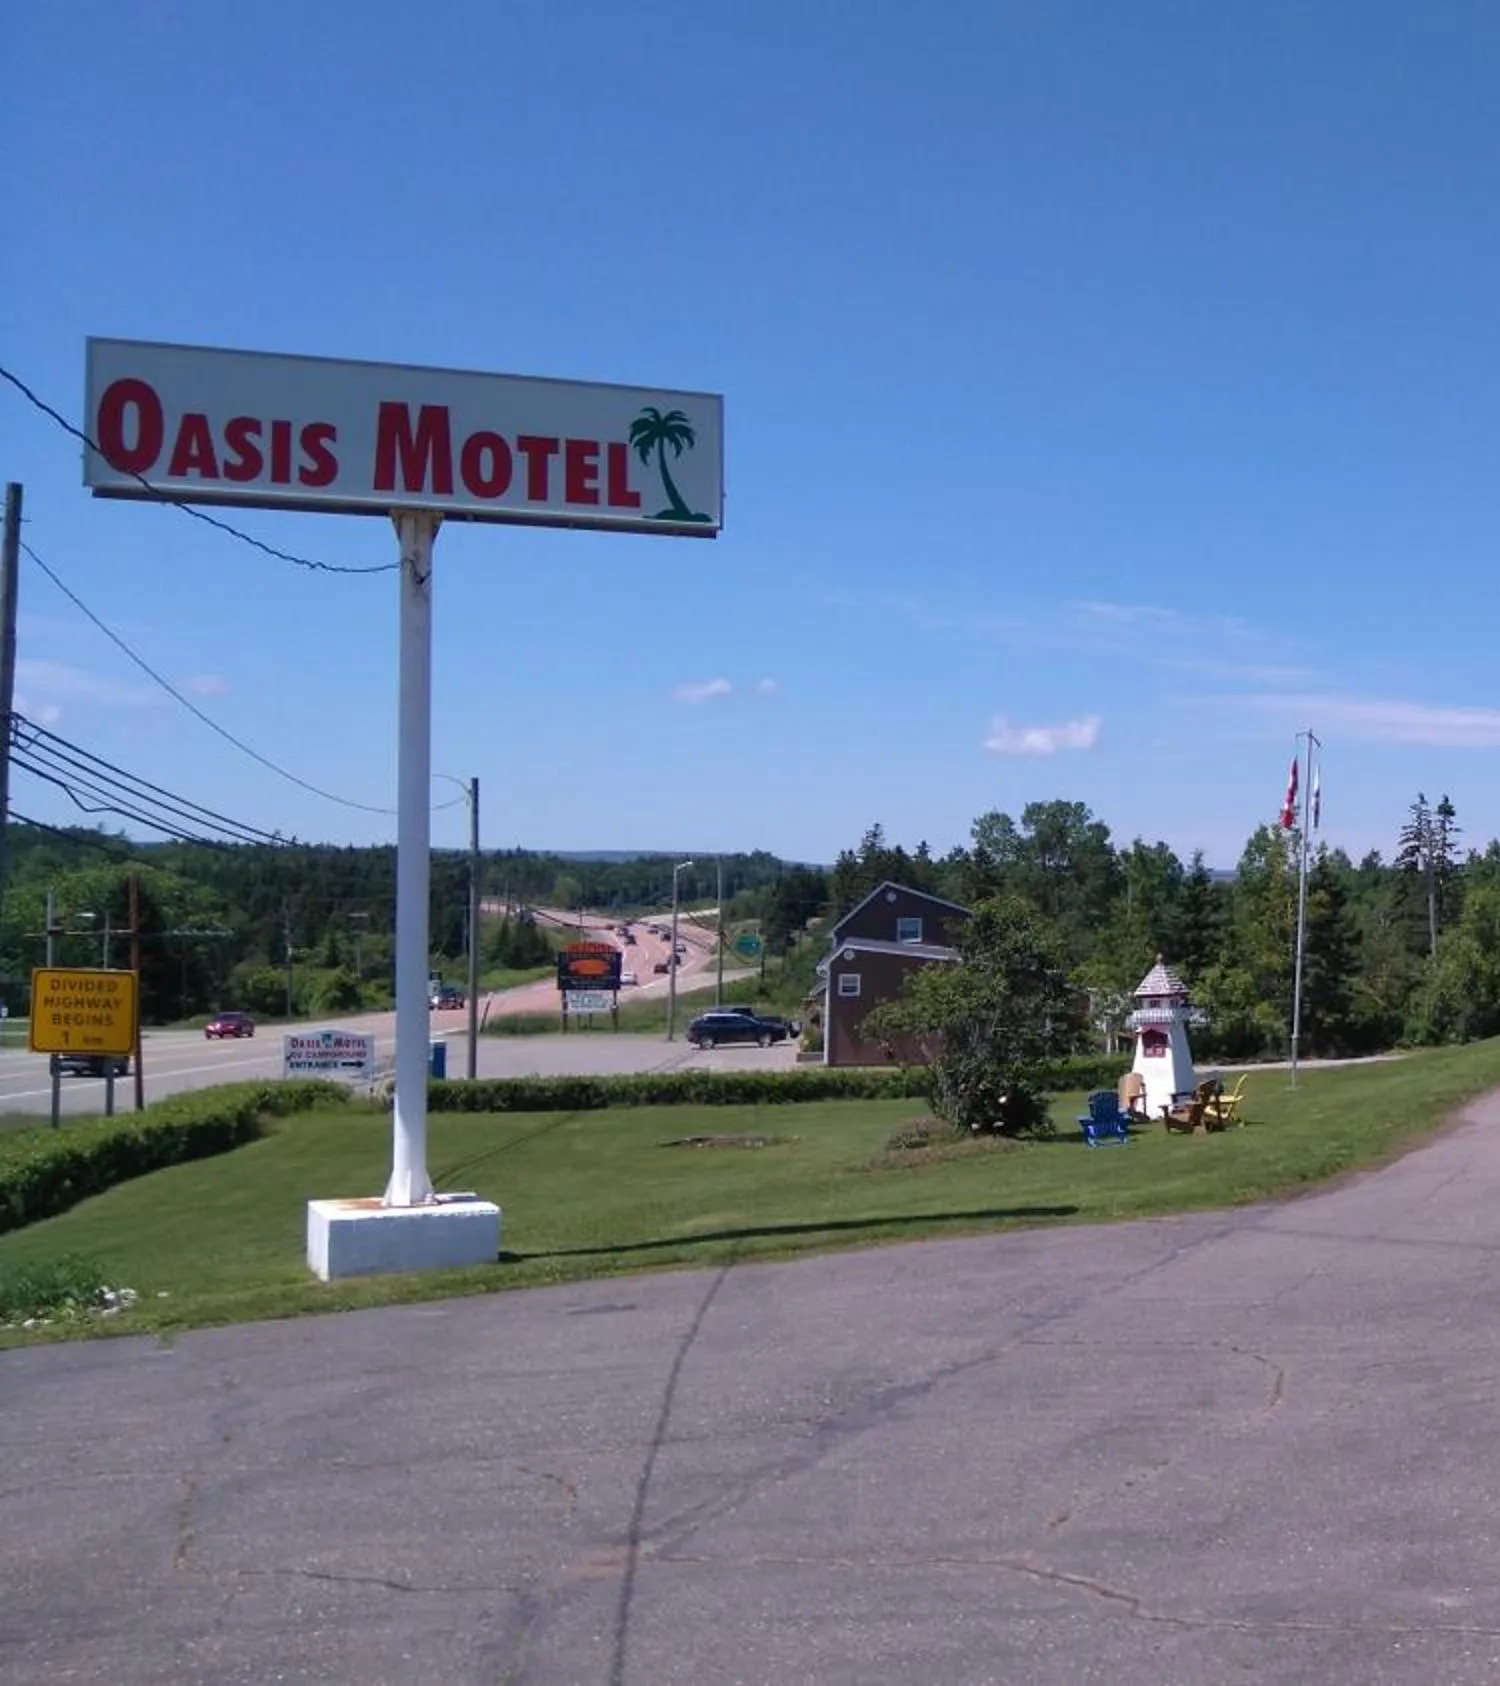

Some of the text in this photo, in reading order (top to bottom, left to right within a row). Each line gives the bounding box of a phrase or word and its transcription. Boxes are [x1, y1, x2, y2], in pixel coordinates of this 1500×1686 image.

[97, 378, 641, 508] OASIS MOTEL
[51, 979, 118, 992] DIVIDED
[44, 996, 121, 1009] HIGHWAY
[52, 1013, 113, 1026] BEGINS
[62, 1031, 69, 1045] 1
[289, 1061, 338, 1069] ENTRANCE
